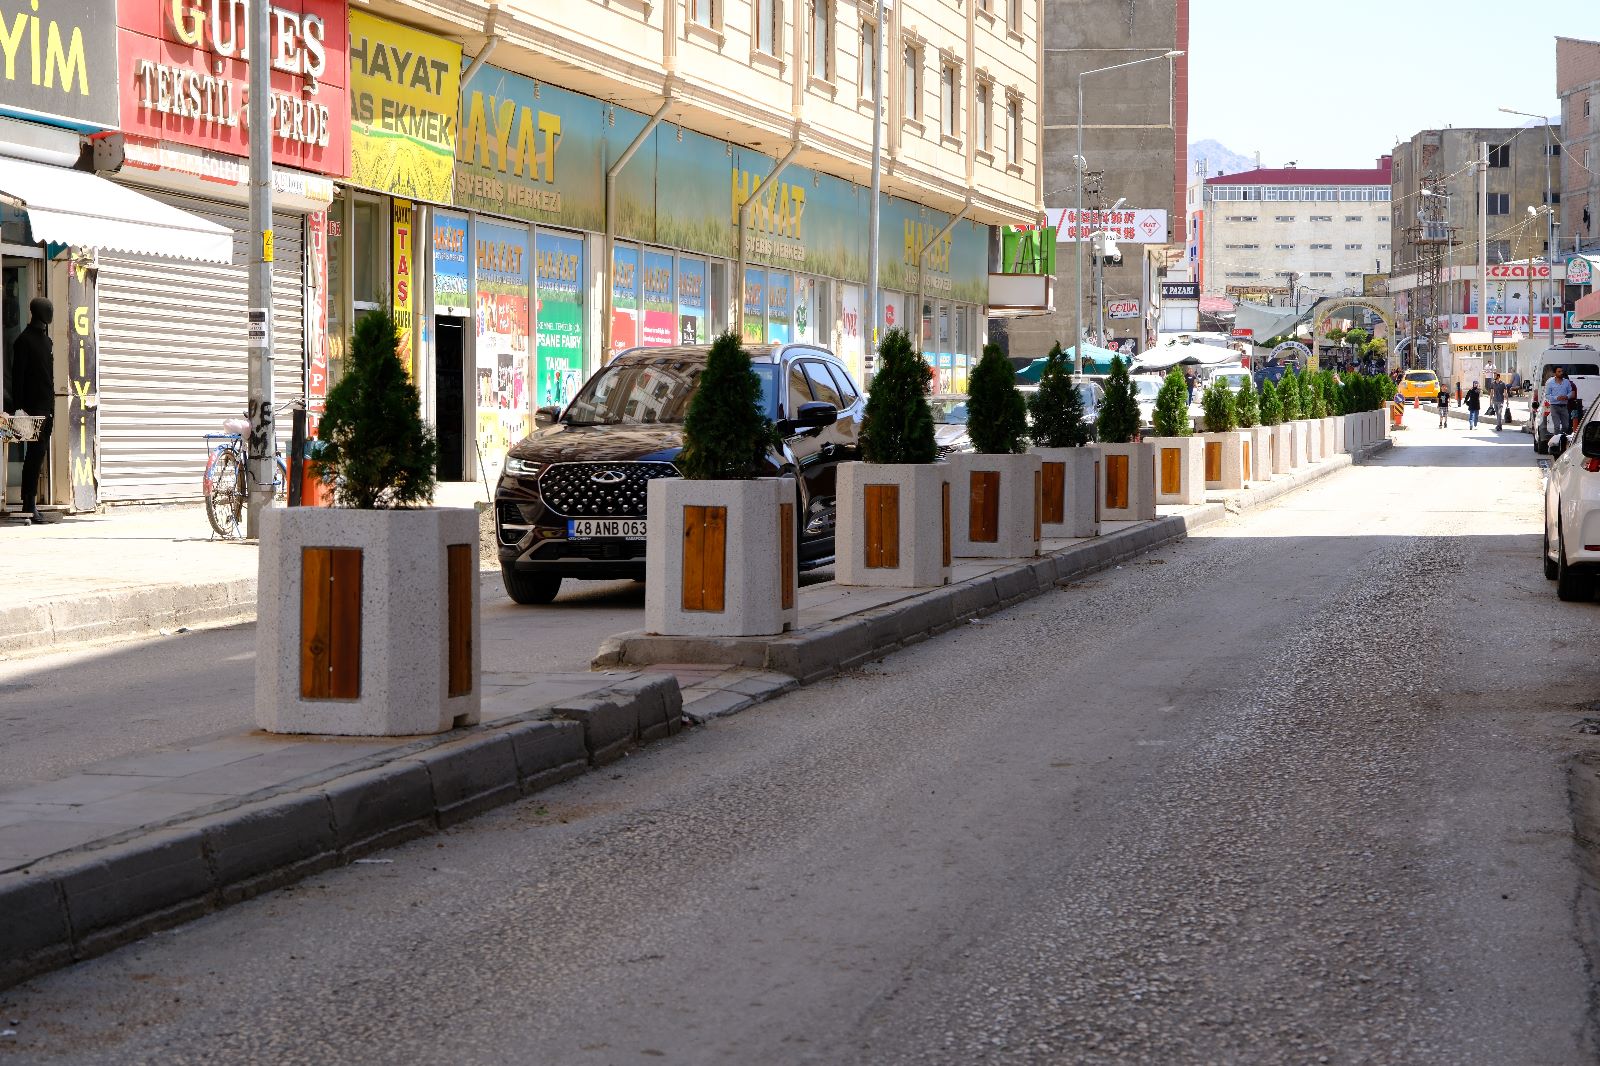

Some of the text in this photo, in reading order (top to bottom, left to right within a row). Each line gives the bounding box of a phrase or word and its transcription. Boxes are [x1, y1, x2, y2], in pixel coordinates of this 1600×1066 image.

[350, 32, 449, 97] HAYAT
[381, 99, 452, 145] EKMEK
[457, 90, 562, 185] AYAT
[732, 167, 805, 240] HAYAT
[476, 239, 524, 275] HAYAT
[1169, 286, 1195, 295] PAZARI
[1487, 315, 1538, 325] ECZANE
[575, 521, 647, 536] 48 ANB 063
